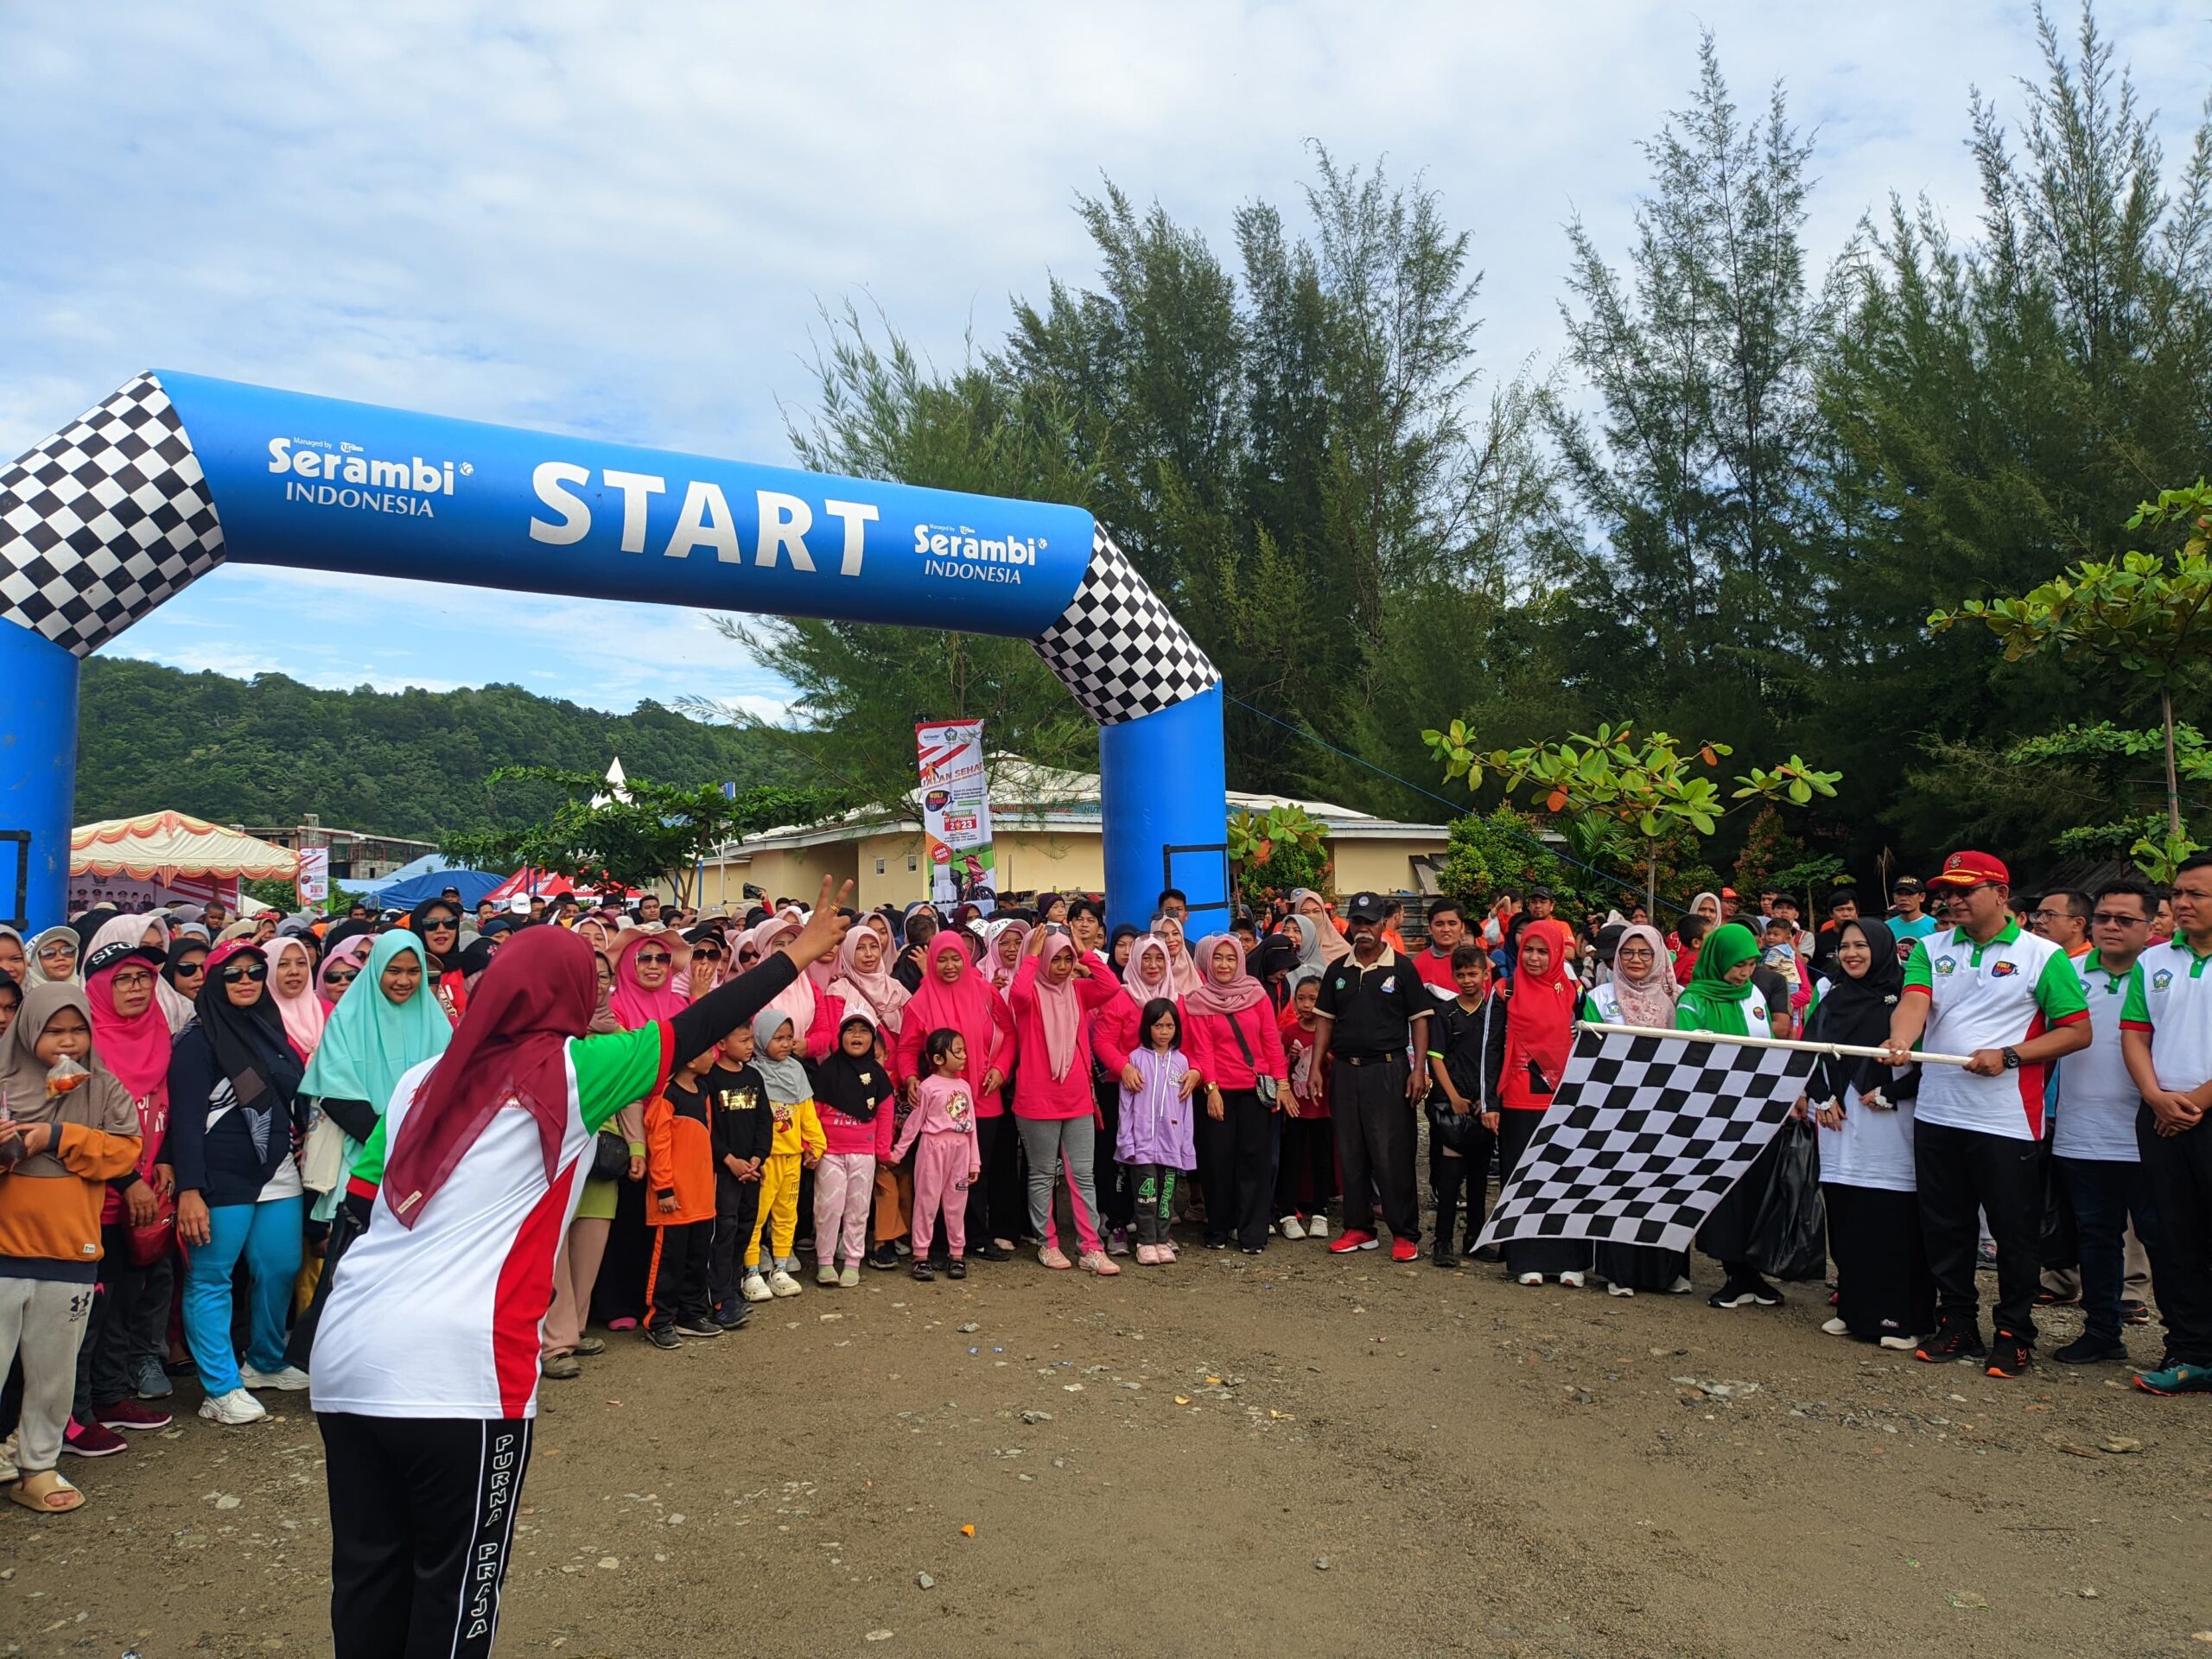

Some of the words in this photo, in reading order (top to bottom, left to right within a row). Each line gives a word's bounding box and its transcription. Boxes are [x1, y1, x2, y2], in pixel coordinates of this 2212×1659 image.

[294, 436, 323, 448] Managed
[324, 440, 333, 450] by
[268, 437, 454, 496] Serambi
[285, 481, 435, 518] INDONESIA
[529, 461, 880, 577] START
[913, 524, 1036, 566] Serambi
[924, 559, 1022, 585] INDONESIA
[923, 772, 952, 786] JALAN
[955, 761, 983, 778] SEHAT
[934, 847, 947, 855] DOOR
[936, 851, 949, 861] PRIZE
[1138, 1177, 1156, 1199] 4
[484, 1433, 514, 1528] PURNA
[466, 1542, 499, 1639] PRAJA
